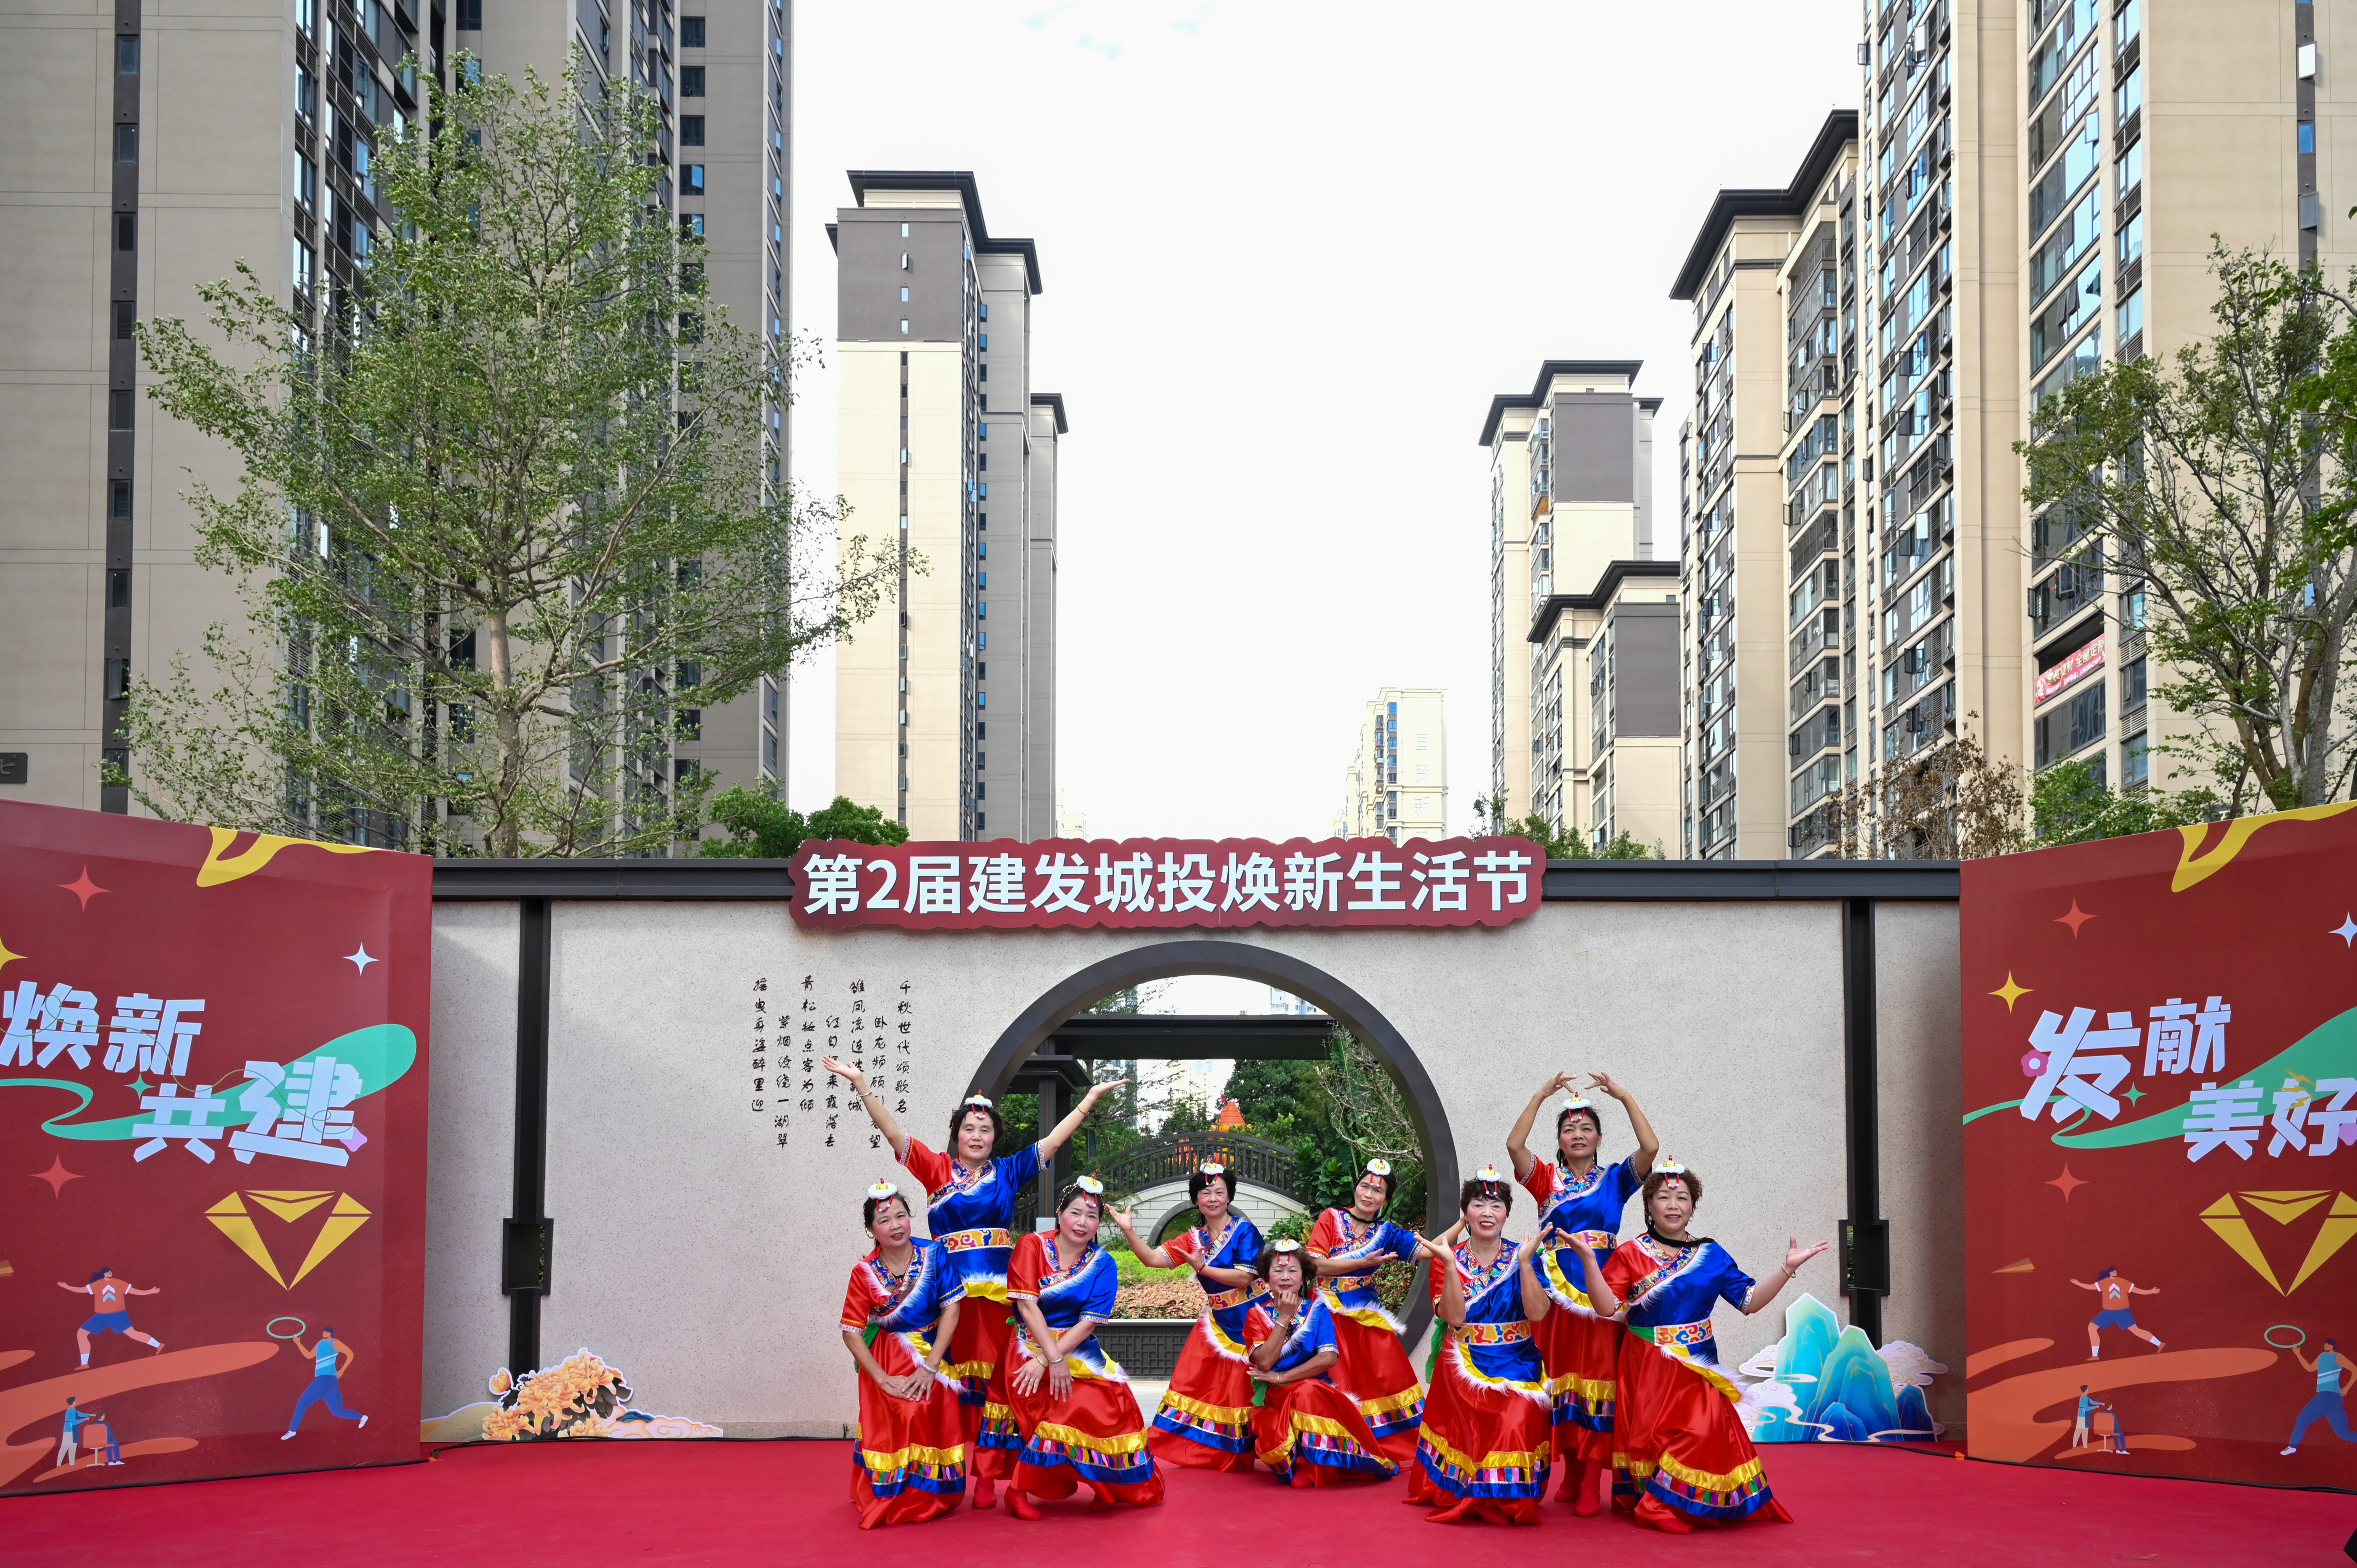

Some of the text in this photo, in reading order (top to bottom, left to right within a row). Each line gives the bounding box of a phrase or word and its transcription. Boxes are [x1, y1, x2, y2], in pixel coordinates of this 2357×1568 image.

[803, 850, 1532, 914] 第2届建发城投焕新生活节
[0, 980, 205, 1076] 焕新
[751, 978, 767, 1112] 摇曳身姿醉里迎
[774, 1015, 792, 1148] 紫烟缭绕一湖翠
[869, 1015, 888, 1149] 卧龙频顾望
[895, 980, 912, 1113] 千秋世代颂歌名
[132, 1056, 363, 1167] 共建
[2182, 1077, 2357, 1163] 美好
